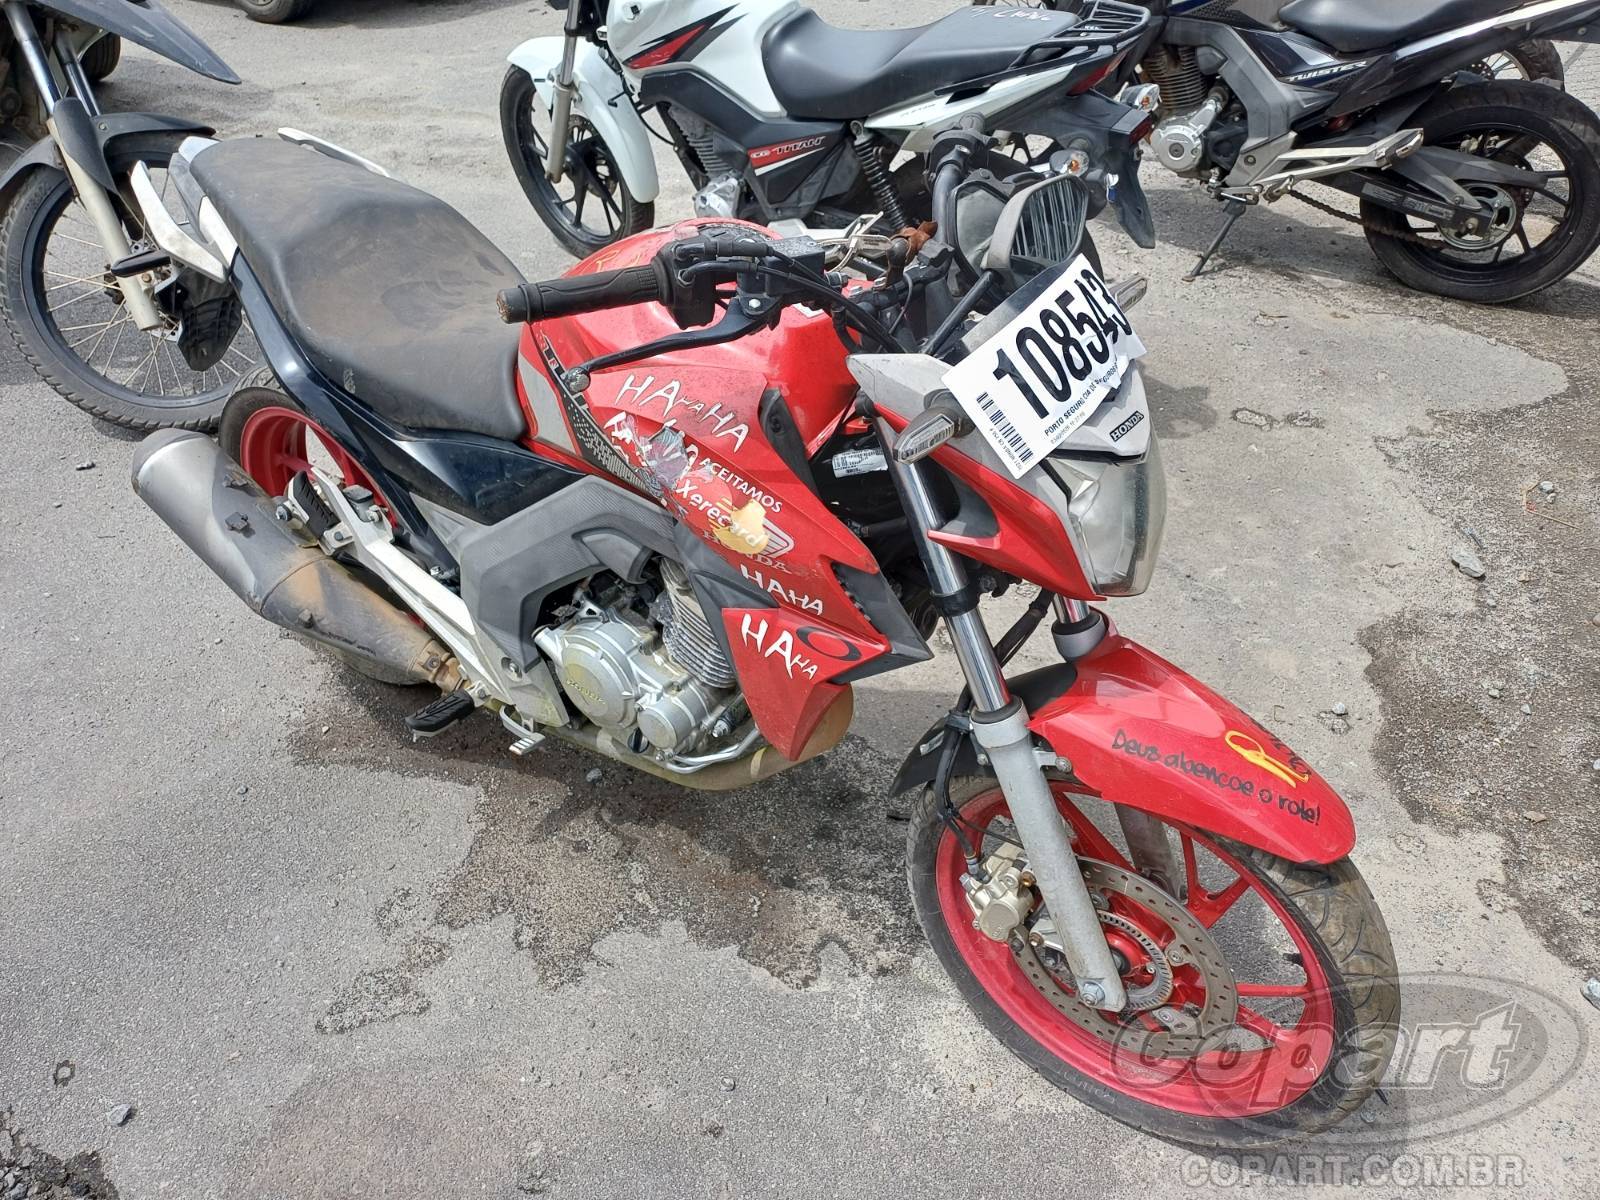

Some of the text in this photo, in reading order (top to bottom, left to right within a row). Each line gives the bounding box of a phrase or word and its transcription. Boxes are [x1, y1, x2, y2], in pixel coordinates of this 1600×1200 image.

[992, 269, 1133, 420] 108543
[1044, 416, 1065, 437] PORTO
[1063, 398, 1086, 419] SEGURO
[1110, 411, 1144, 442] HONDA
[699, 457, 783, 514] ACEITAMOS
